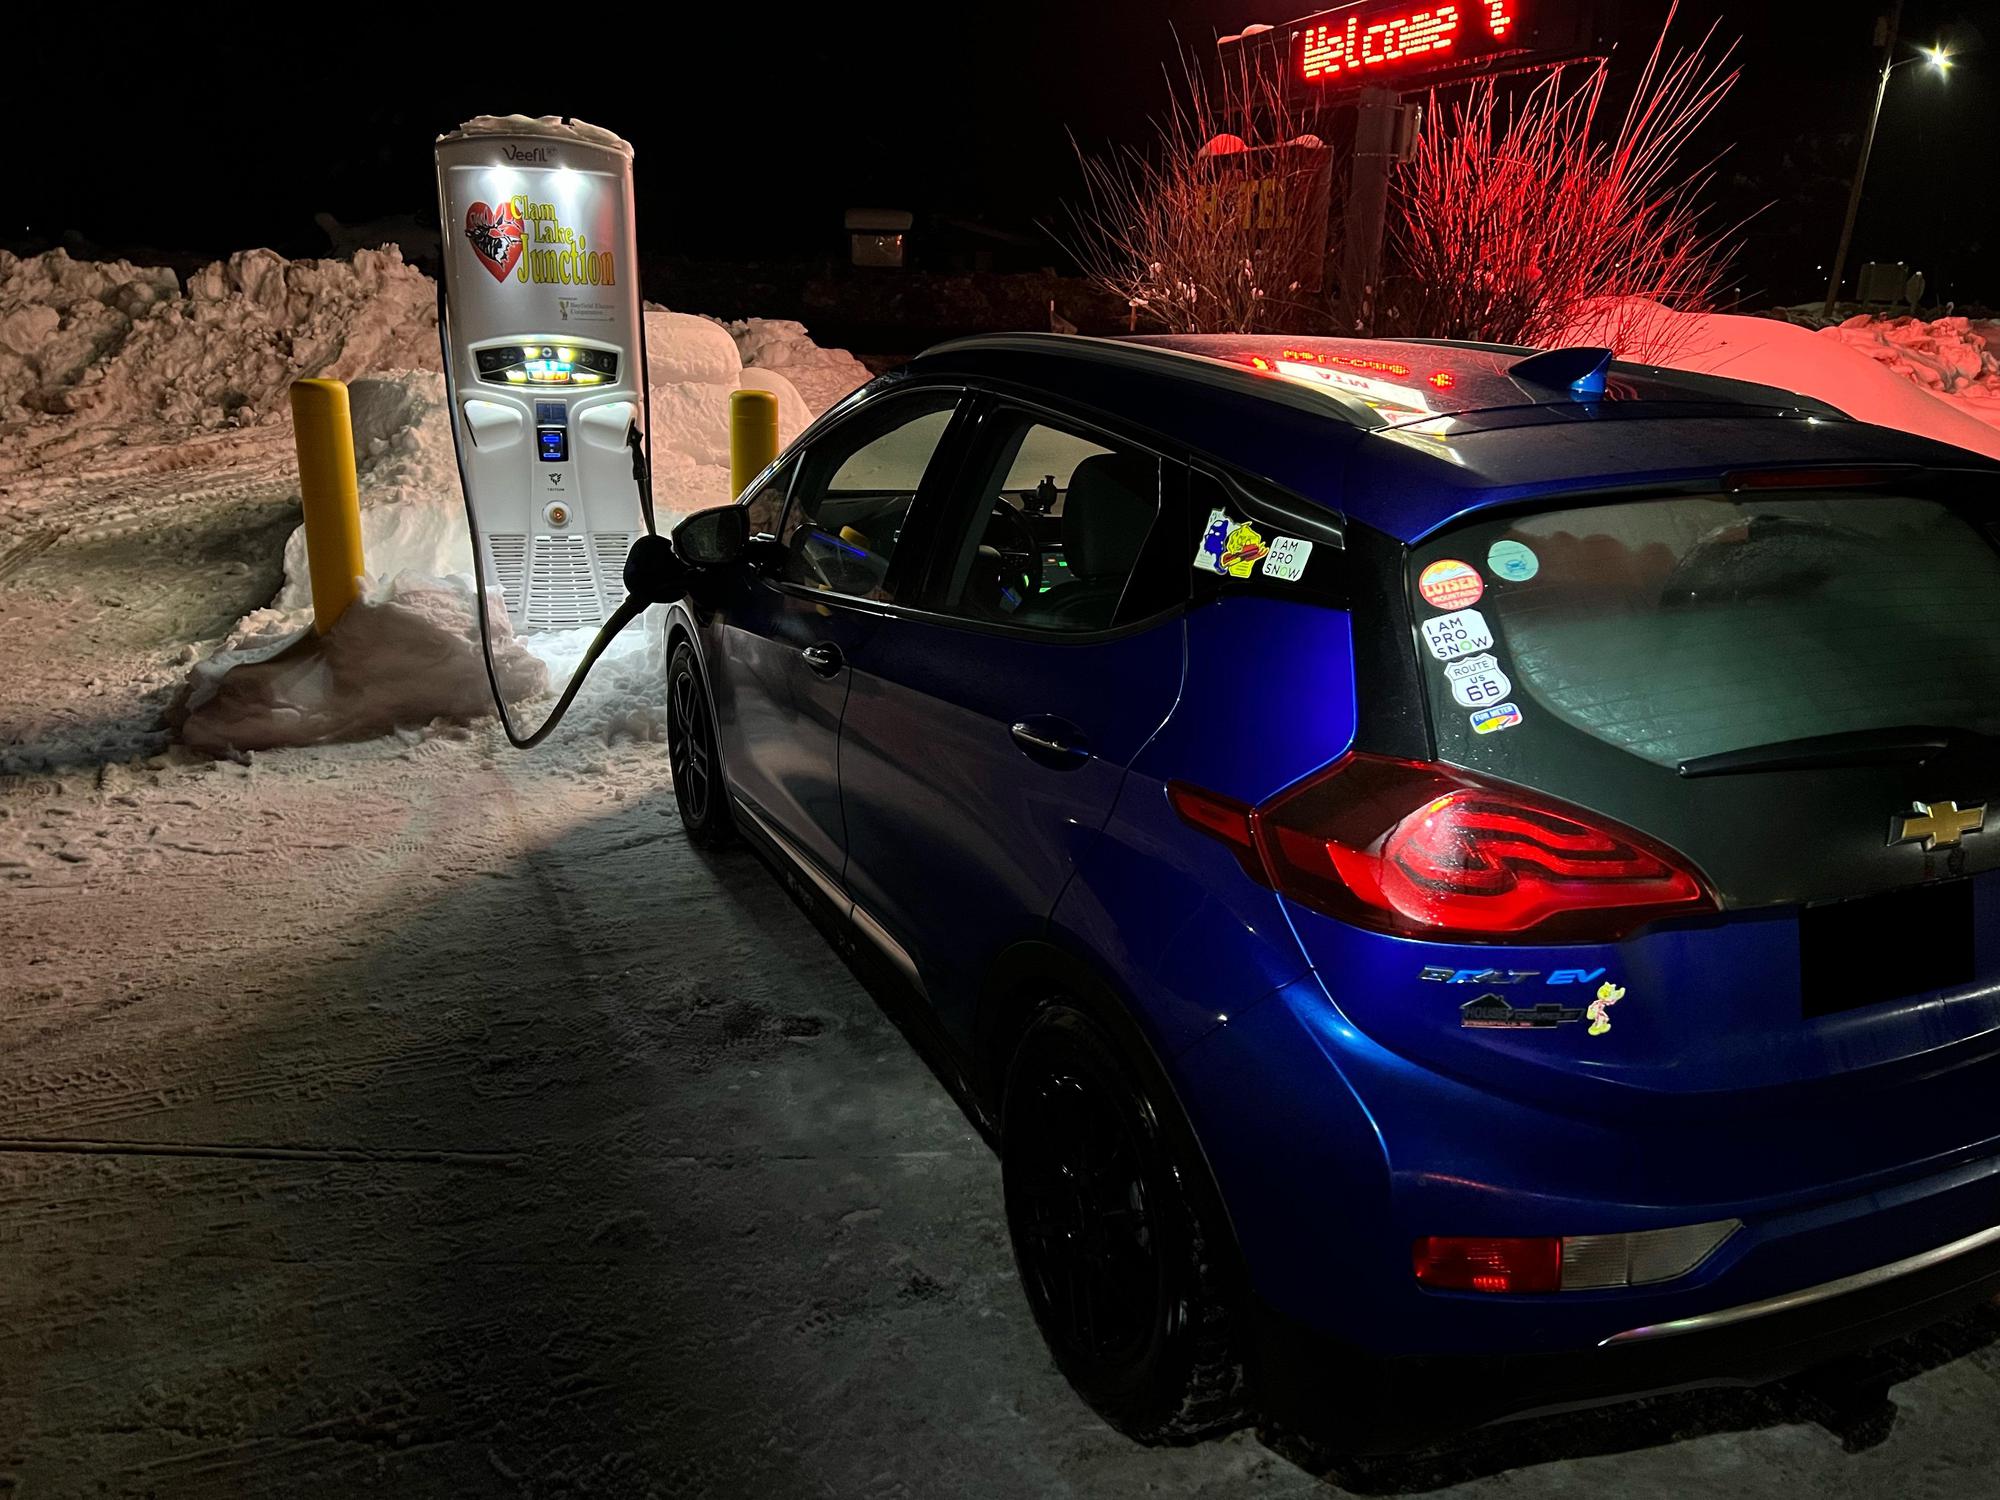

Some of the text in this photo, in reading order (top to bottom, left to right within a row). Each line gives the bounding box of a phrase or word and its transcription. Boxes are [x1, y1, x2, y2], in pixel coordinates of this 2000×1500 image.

[1303, 6, 1458, 78] Welcome
[502, 144, 548, 162] Veefil
[510, 195, 556, 221] Clam
[534, 220, 574, 244] Lake
[517, 233, 616, 286] Junction
[1273, 538, 1280, 549] I
[1280, 539, 1299, 552] AM
[1269, 550, 1293, 565] PRO
[1264, 563, 1301, 580] SNOW
[1426, 616, 1463, 636] I AM
[1431, 628, 1468, 647] PRO
[1436, 635, 1488, 658] SNOW
[1454, 660, 1490, 677] ROUTE
[1469, 674, 1486, 685] US
[1466, 680, 1500, 702] 66
[1545, 967, 1606, 985] EV
